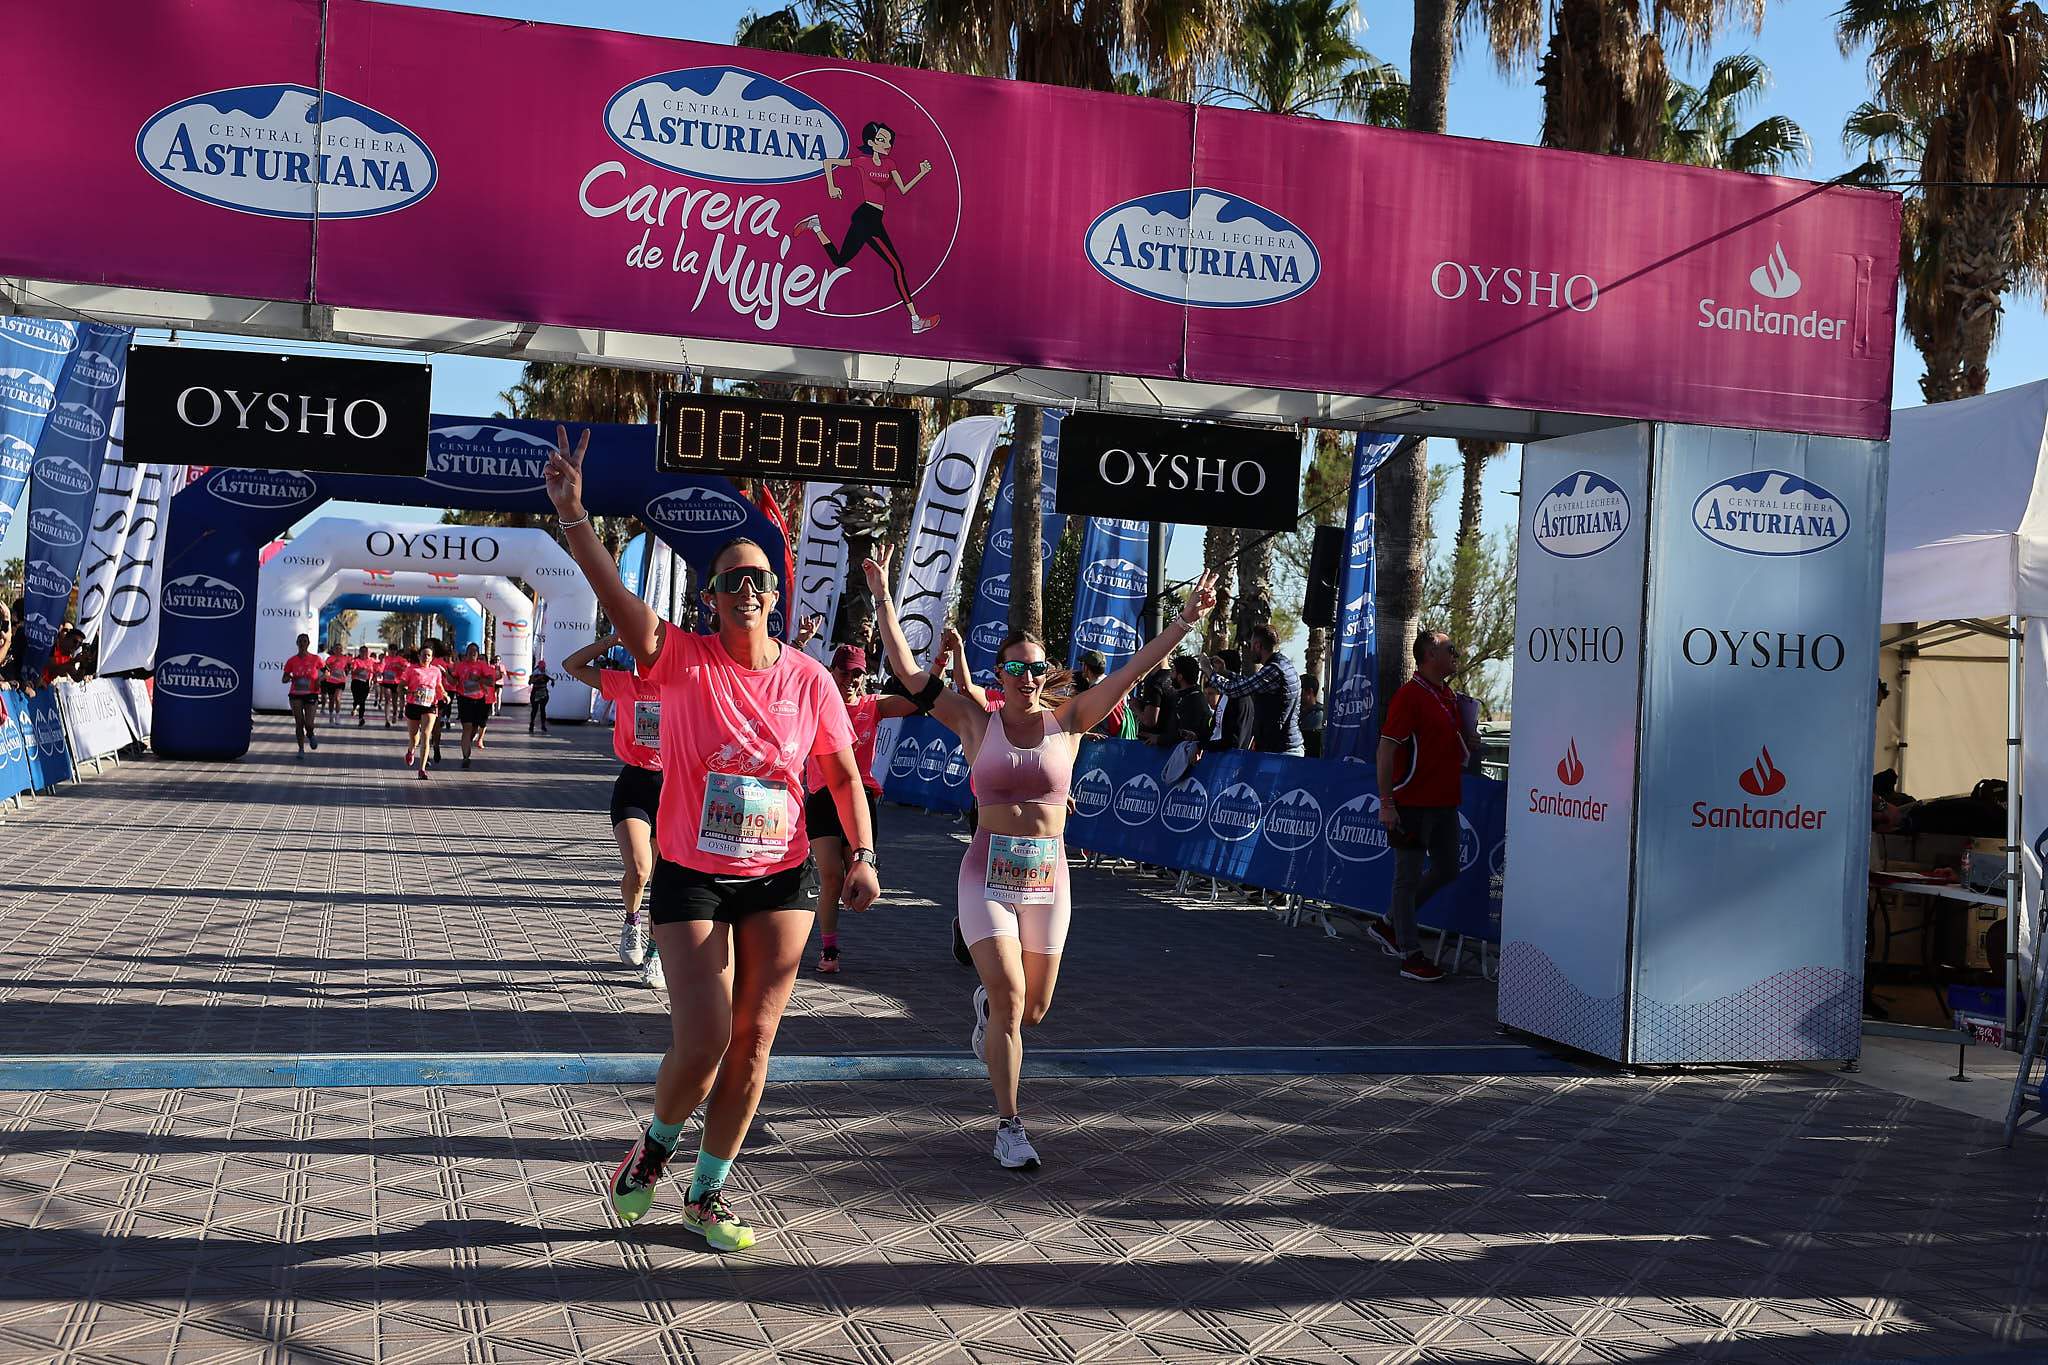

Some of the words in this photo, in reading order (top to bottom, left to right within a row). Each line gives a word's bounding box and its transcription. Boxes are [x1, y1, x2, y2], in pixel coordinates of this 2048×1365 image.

[662, 99, 740, 119] CENTRAL
[747, 110, 824, 129] LECHERA
[209, 123, 303, 144] CENTRAL
[622, 98, 829, 162] ASTURIANA
[160, 122, 415, 193] ASTURIANA
[578, 160, 781, 238] Carrera
[1142, 223, 1215, 242] CENTRAL
[1222, 231, 1297, 250] LECHERA
[1103, 223, 1302, 284] ASTURIANA
[626, 229, 664, 270] de
[672, 229, 699, 275] la
[691, 232, 853, 331] Mujer
[1431, 261, 1599, 312] OYSHO
[1698, 298, 1847, 341] Santander
[176, 386, 388, 439] OYSHO
[440, 443, 492, 453] CENTRAL
[678, 407, 899, 472] 00:38:26
[38, 462, 89, 491] ASTURIANA
[1098, 448, 1266, 496] OYSHO
[213, 476, 308, 498] ASTURIANA
[79, 400, 138, 624] OYSH
[654, 503, 741, 522] ASTURIANA
[1553, 500, 1583, 514] CENTRAL
[1585, 497, 1621, 510] LECHERA
[1702, 498, 1838, 539] ASTURIANA
[1728, 497, 1779, 510] CENTRAL
[1782, 501, 1834, 514] LECHERA
[30, 515, 77, 542] ASTURIANA
[1538, 507, 1623, 539] ASTURIANA
[366, 530, 500, 563] OYSHO
[899, 452, 977, 657] OYSHO
[283, 556, 325, 567] OYSHO
[535, 567, 575, 577] OYSHO
[1088, 567, 1148, 594] ASTURIANA
[164, 589, 239, 611] ASTURIANA
[262, 608, 301, 618] OYSHO
[553, 620, 591, 632] OYSHO
[1078, 626, 1137, 651] ASTURIANA
[1528, 626, 1624, 664] OYSHO
[1682, 627, 1846, 672] OYSHO
[158, 668, 234, 689] ASTURIANA
[1116, 791, 1156, 814] ASTURIANA
[1163, 796, 1203, 820] ASTURIANA
[1210, 802, 1257, 829] ASTURIANA
[1529, 788, 1608, 822] Santander
[1691, 802, 1828, 831] Santander
[1266, 809, 1316, 838] ASTURIANA
[1329, 815, 1388, 848] ASTURIANA
[708, 841, 737, 853] OYSHO
